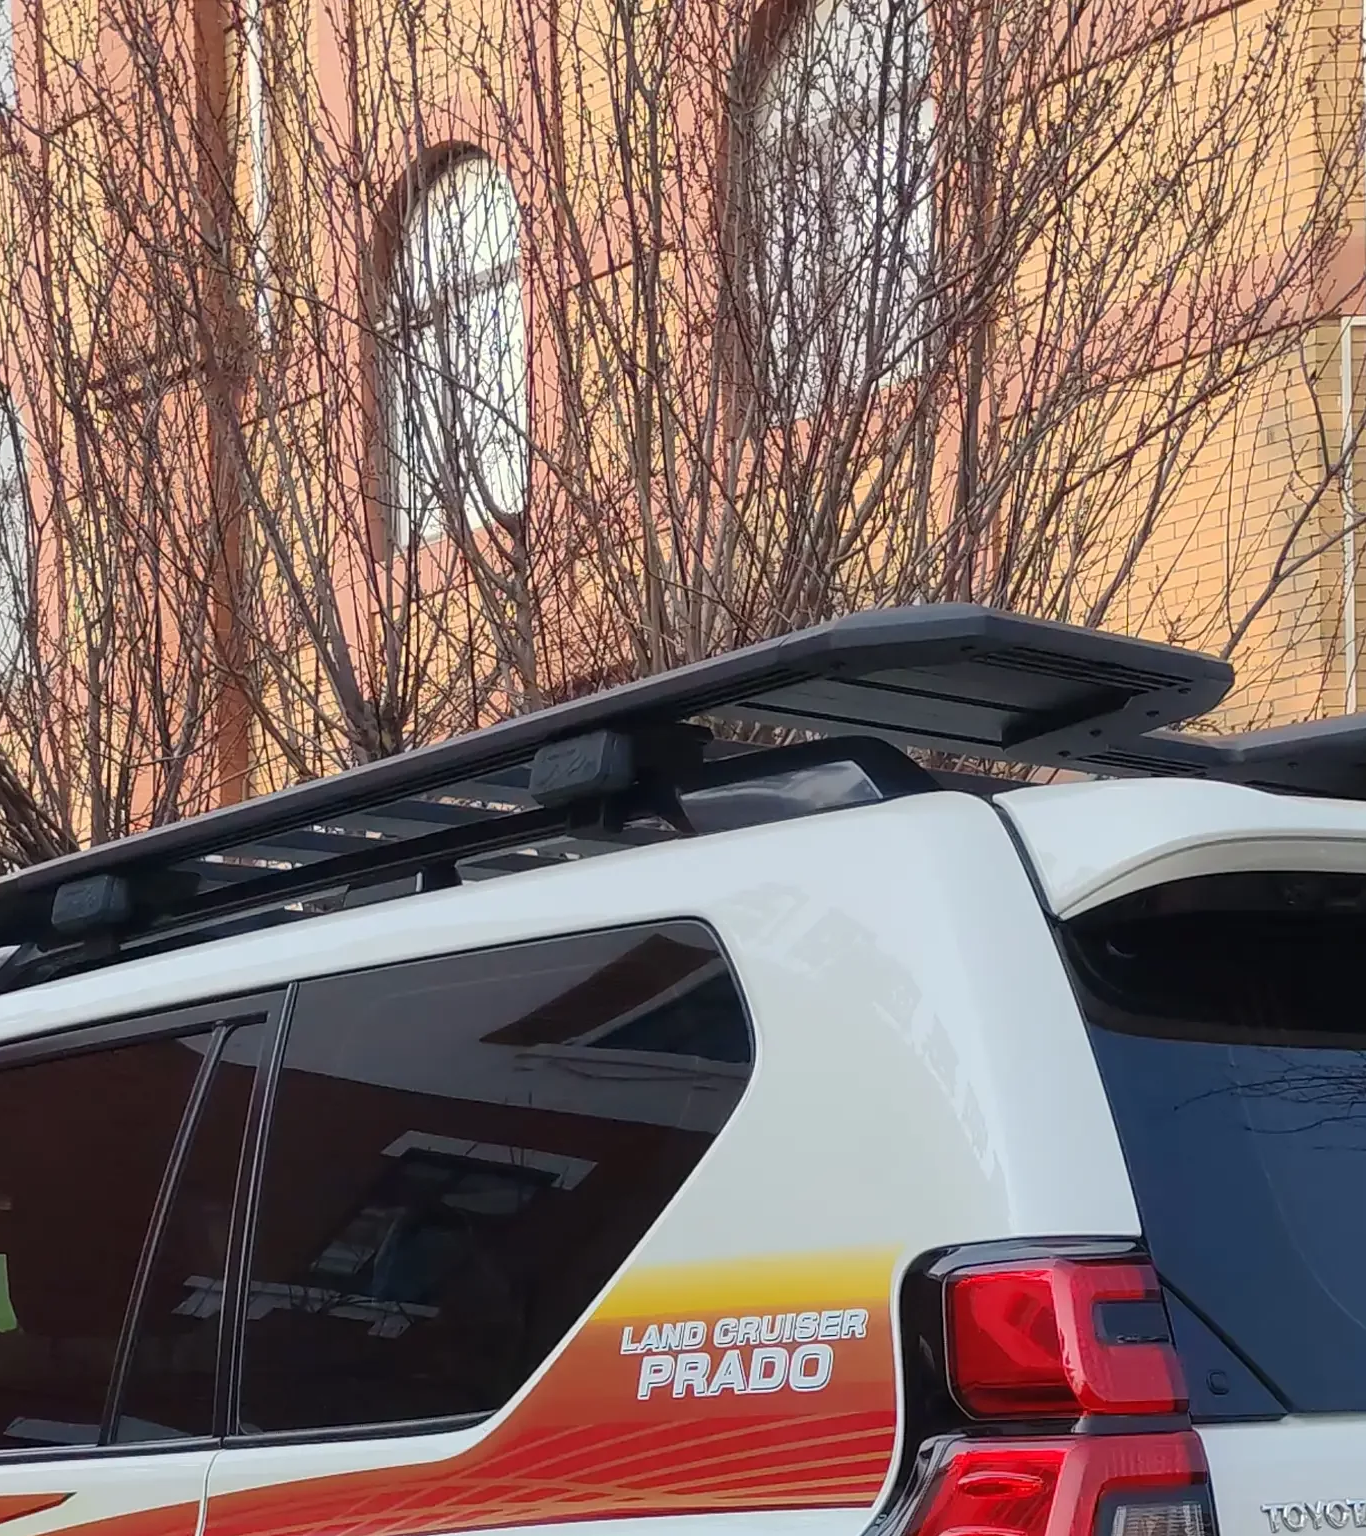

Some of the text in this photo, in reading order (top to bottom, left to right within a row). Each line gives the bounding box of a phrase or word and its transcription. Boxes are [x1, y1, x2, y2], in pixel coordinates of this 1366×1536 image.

[620, 1309, 869, 1355] LAND CRUISER
[637, 1344, 835, 1400] PRADO
